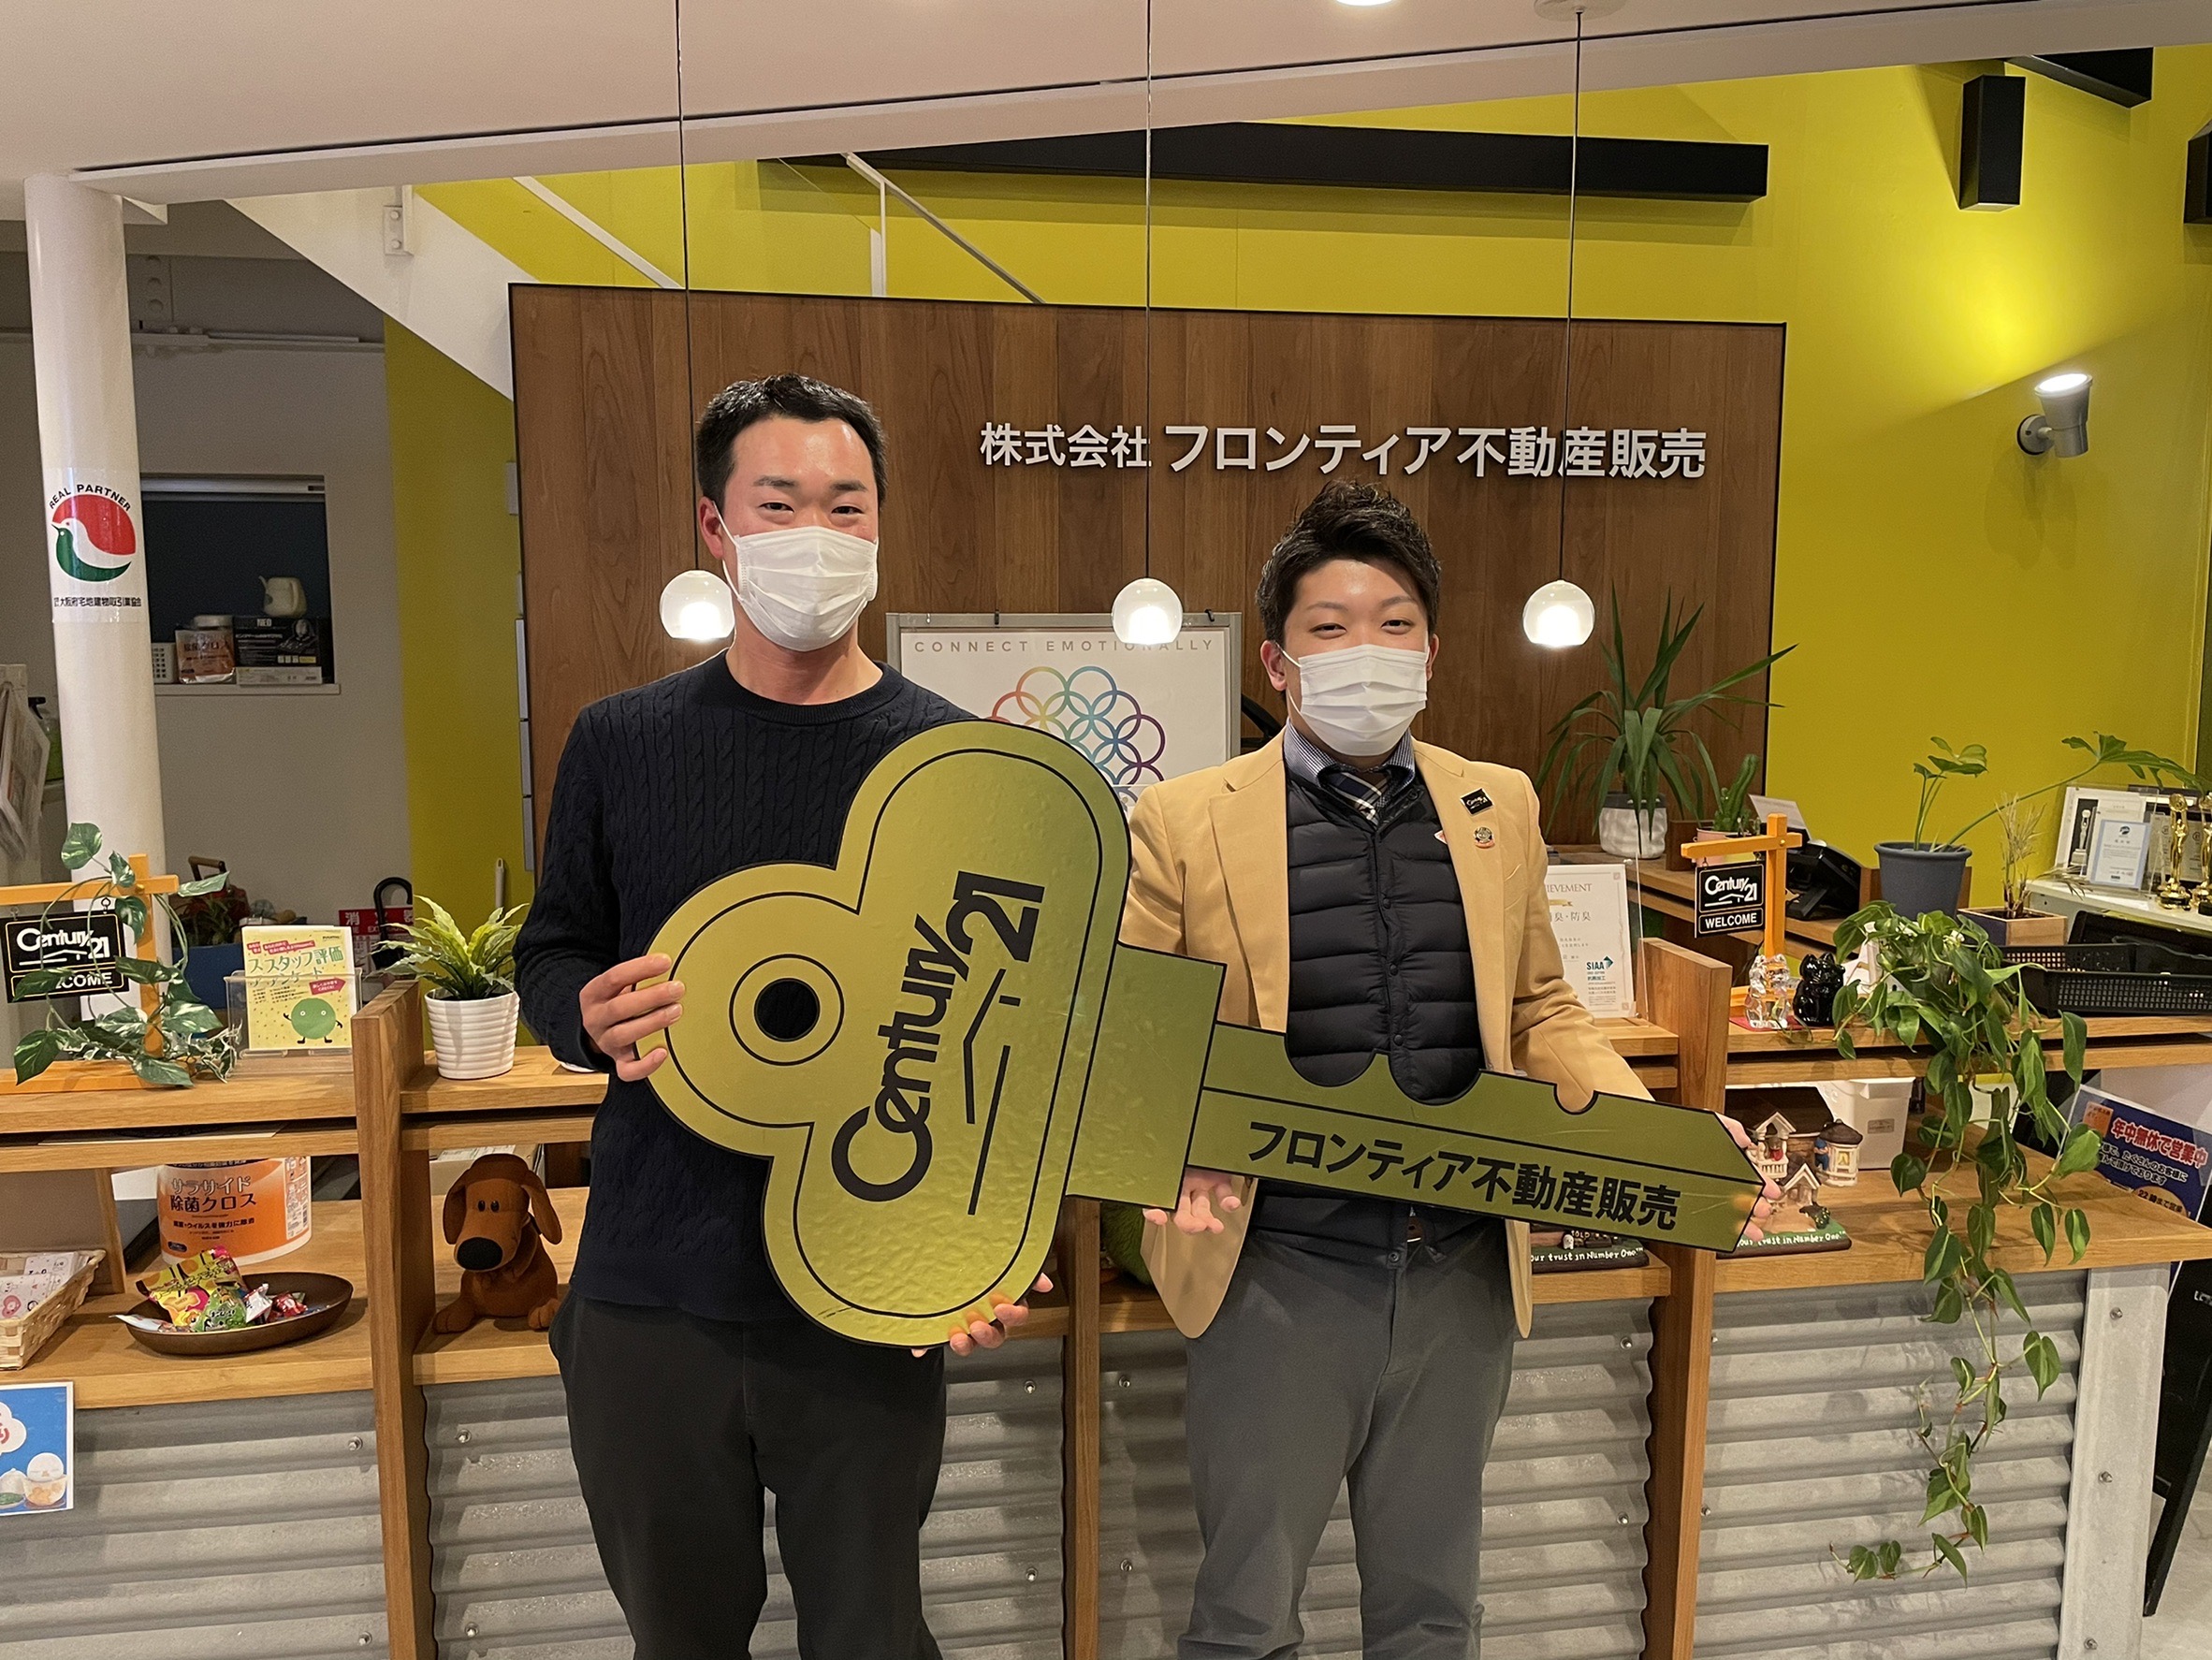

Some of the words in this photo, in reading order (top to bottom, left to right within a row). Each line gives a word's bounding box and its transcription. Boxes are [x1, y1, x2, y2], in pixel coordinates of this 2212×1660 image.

[980, 421, 1152, 468] 株式会社
[1165, 424, 1707, 479] フロンティア不動産販売
[49, 488, 71, 509] REAL
[77, 484, 131, 512] PARTNER
[914, 641, 1029, 653] CONNECT
[1547, 883, 1593, 893] IEVEMENT
[1704, 875, 1750, 896] Century
[1743, 882, 1758, 902] 21
[1550, 910, 1591, 922] 臭・防臭
[1705, 912, 1757, 929] WELCOME
[16, 927, 95, 952] Century
[87, 936, 110, 960] 21
[264, 945, 344, 973] スタッフ評価
[1586, 961, 1605, 970] SIAA
[56, 972, 113, 989] COME
[831, 913, 969, 1202] Century
[945, 870, 1045, 963] 21
[2111, 1117, 2209, 1170] 年中無休で営業中
[171, 1175, 251, 1195] サラサイド
[1247, 1121, 1681, 1231] フロンティア不動産販売
[170, 1193, 257, 1213] 除菌クロス
[1783, 1236, 1793, 1245] in
[1793, 1234, 1824, 1245] Number
[1530, 1254, 1545, 1262] our
[1548, 1253, 1573, 1262] trust
[1575, 1253, 1585, 1261] in
[1586, 1251, 1620, 1260] Number
